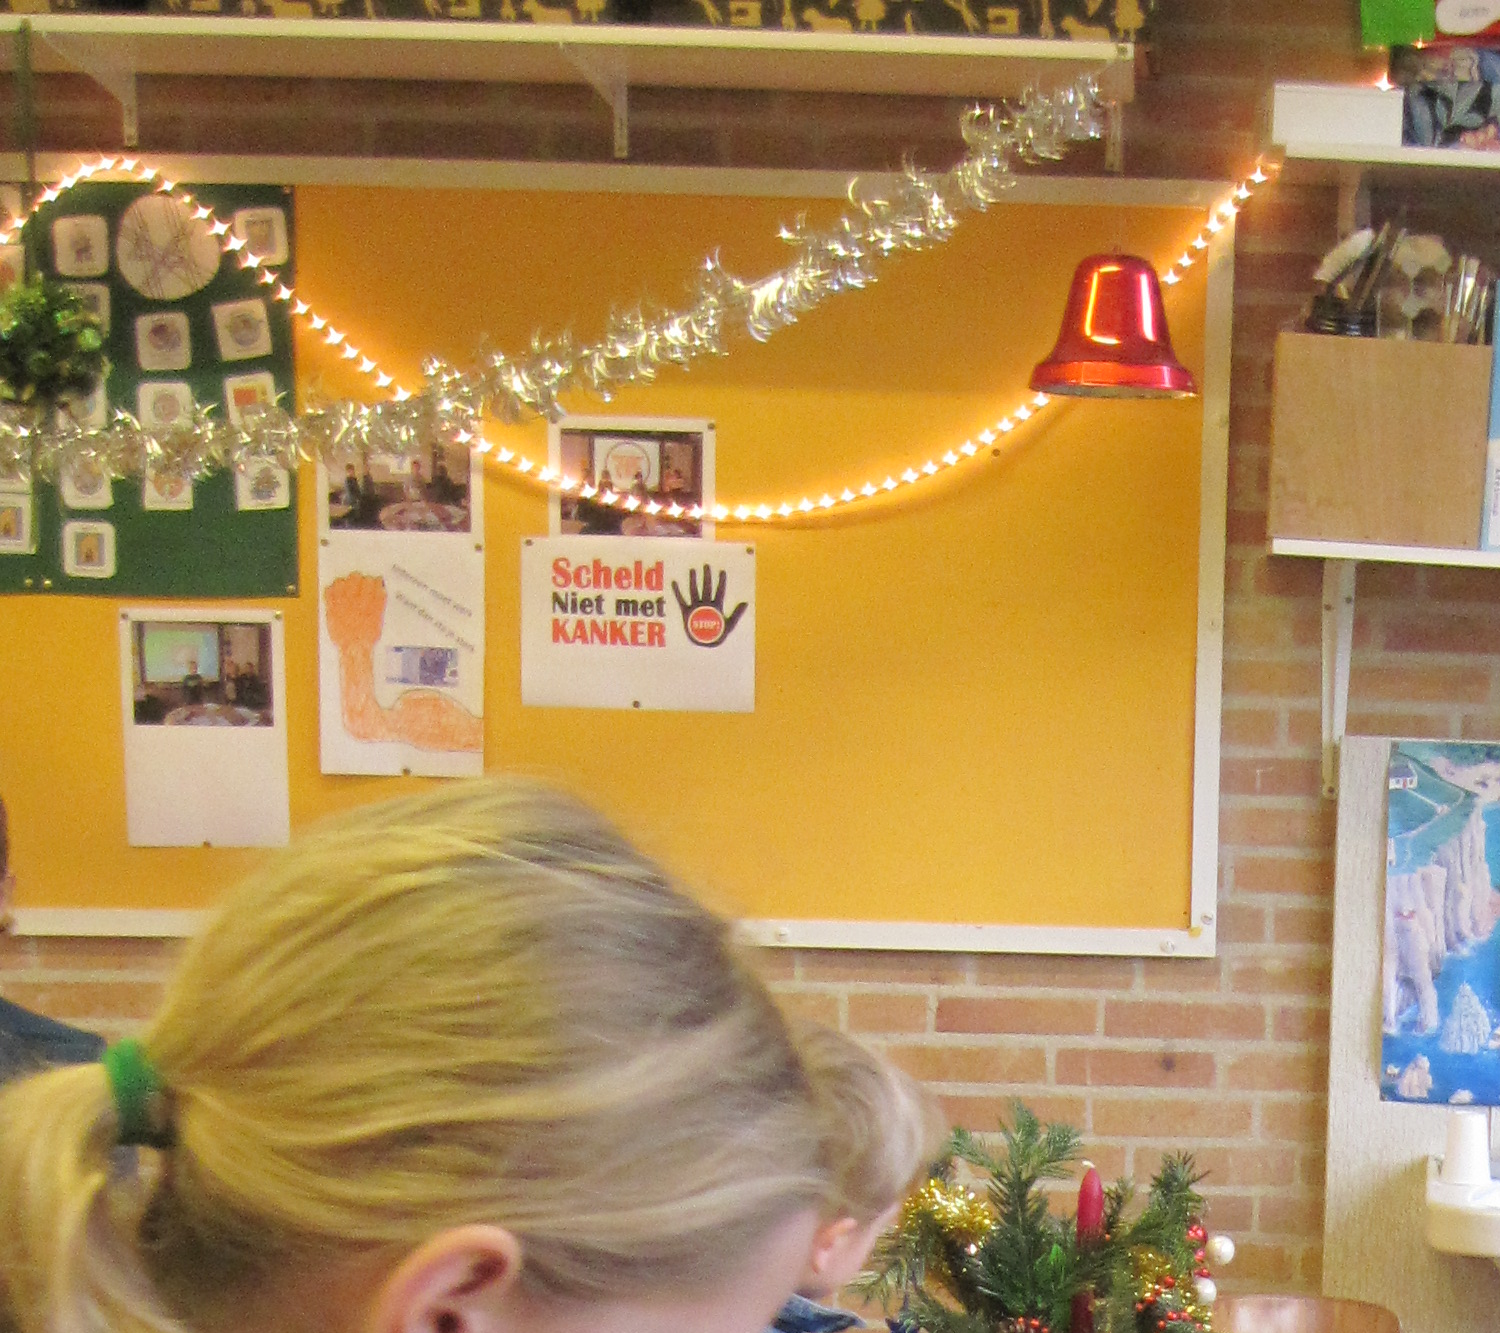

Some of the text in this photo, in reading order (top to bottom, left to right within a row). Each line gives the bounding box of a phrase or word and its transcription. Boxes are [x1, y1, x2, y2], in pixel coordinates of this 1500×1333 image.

[551, 557, 665, 591] Scheld
[551, 592, 666, 618] Niet met
[551, 618, 667, 648] KANKER
